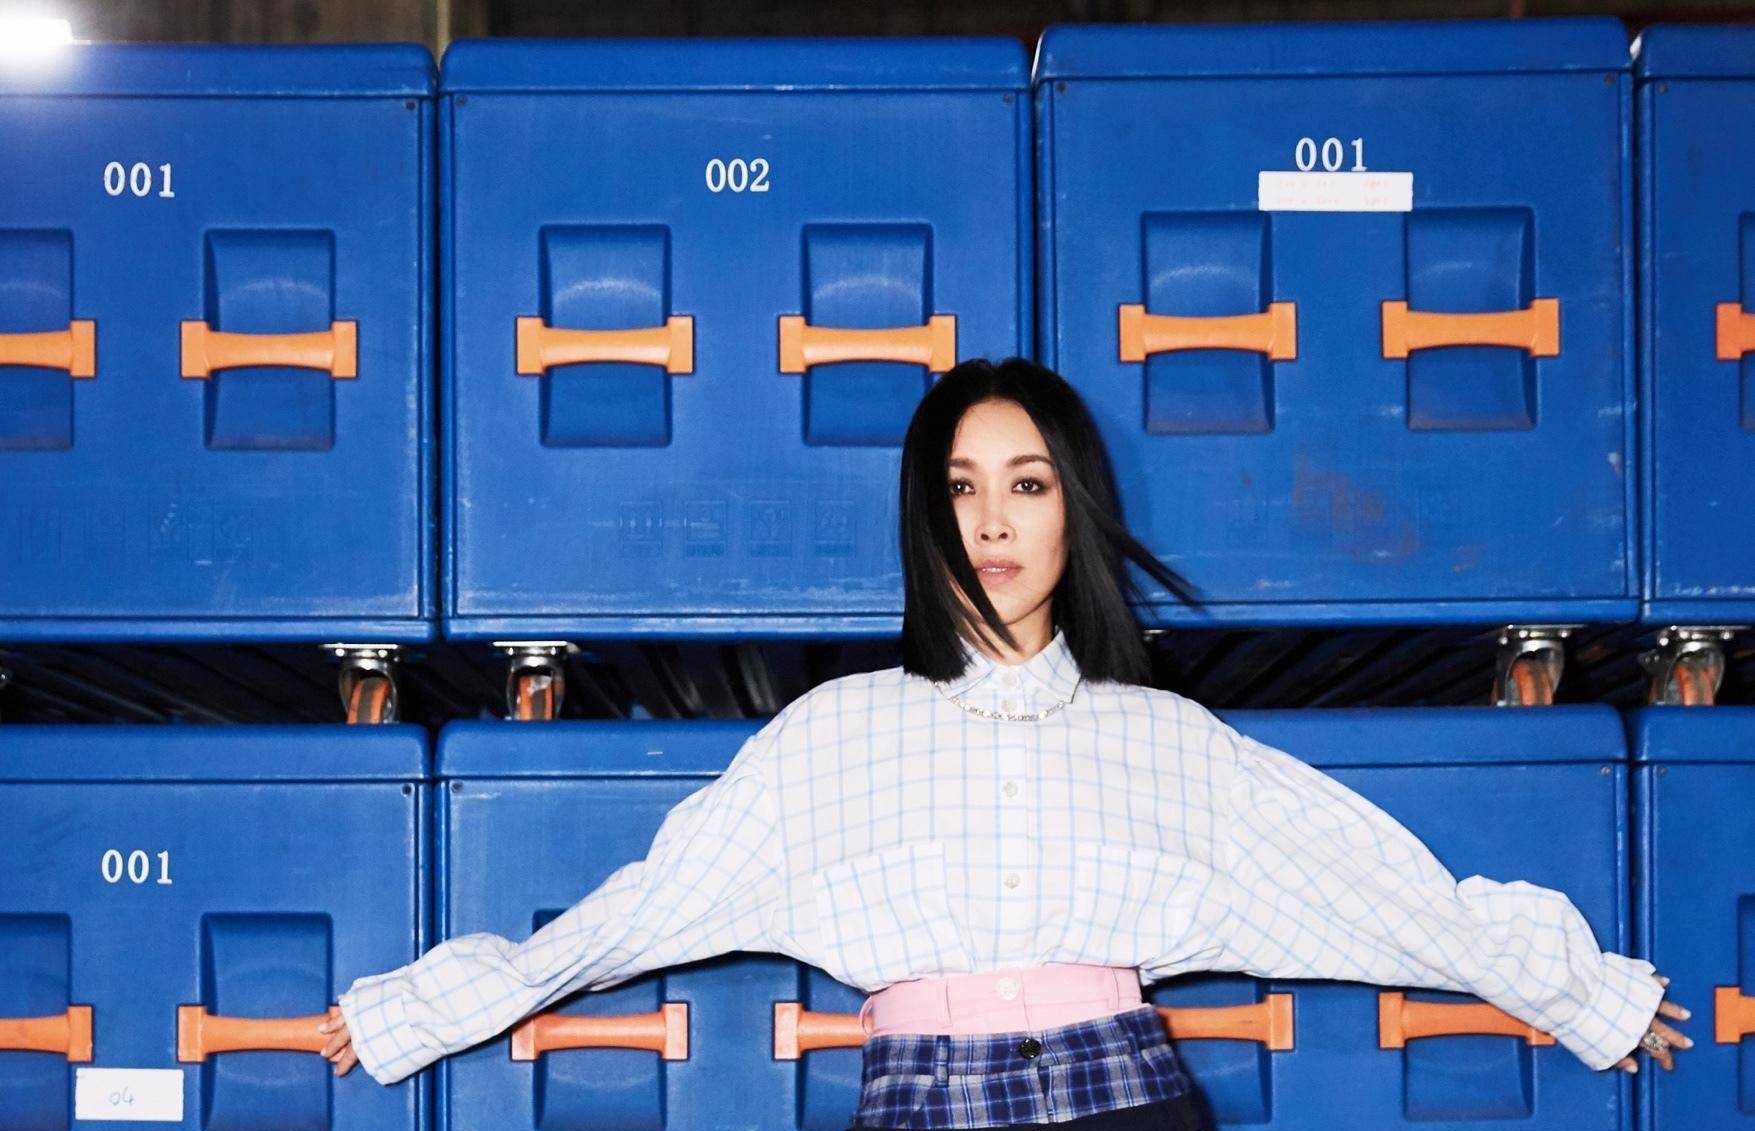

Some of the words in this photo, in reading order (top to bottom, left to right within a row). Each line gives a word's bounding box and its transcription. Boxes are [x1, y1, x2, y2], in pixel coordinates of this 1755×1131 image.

[1295, 137, 1367, 171] 001
[103, 162, 175, 198] 001
[705, 158, 770, 193] 002
[101, 849, 173, 885] 001
